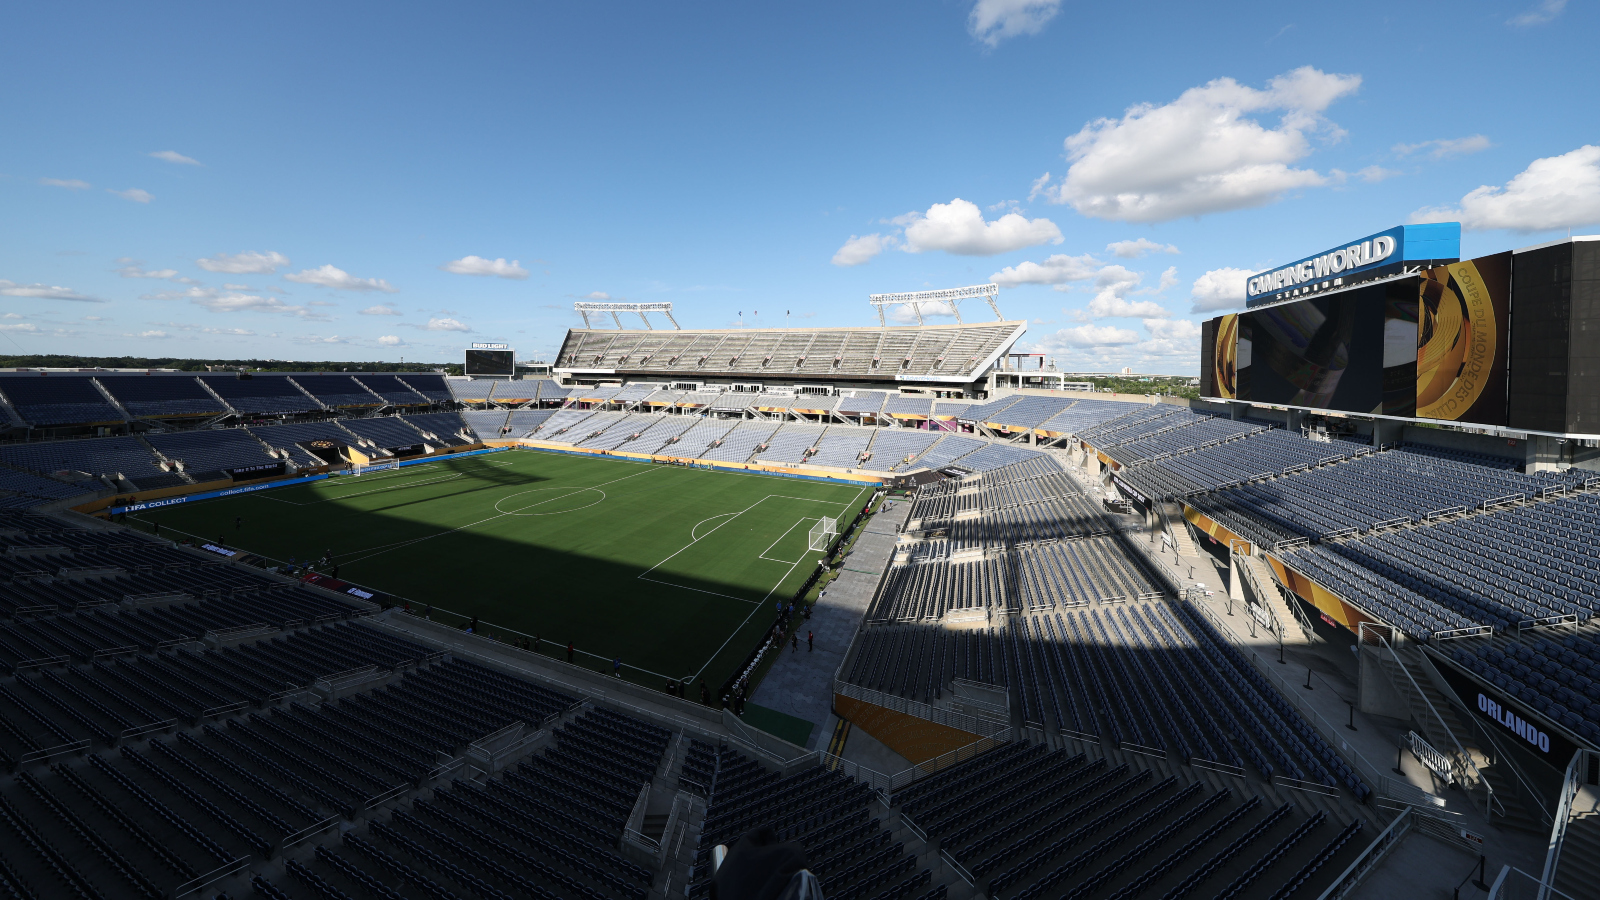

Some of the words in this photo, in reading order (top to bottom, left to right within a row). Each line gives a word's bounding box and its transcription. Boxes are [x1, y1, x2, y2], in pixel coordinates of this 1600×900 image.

[1248, 260, 1313, 297] CAMPING
[1312, 236, 1395, 278] WORLD
[1276, 277, 1344, 300] STADIUM
[1457, 267, 1483, 307] COUPE
[1474, 309, 1487, 328] DU
[1467, 330, 1487, 381] MONDE
[1455, 378, 1475, 403] DES
[219, 484, 270, 496] collect.fifa.com
[125, 503, 146, 512] FIFA
[148, 496, 187, 508] COLLECT
[1477, 693, 1550, 753] ORLANDO
